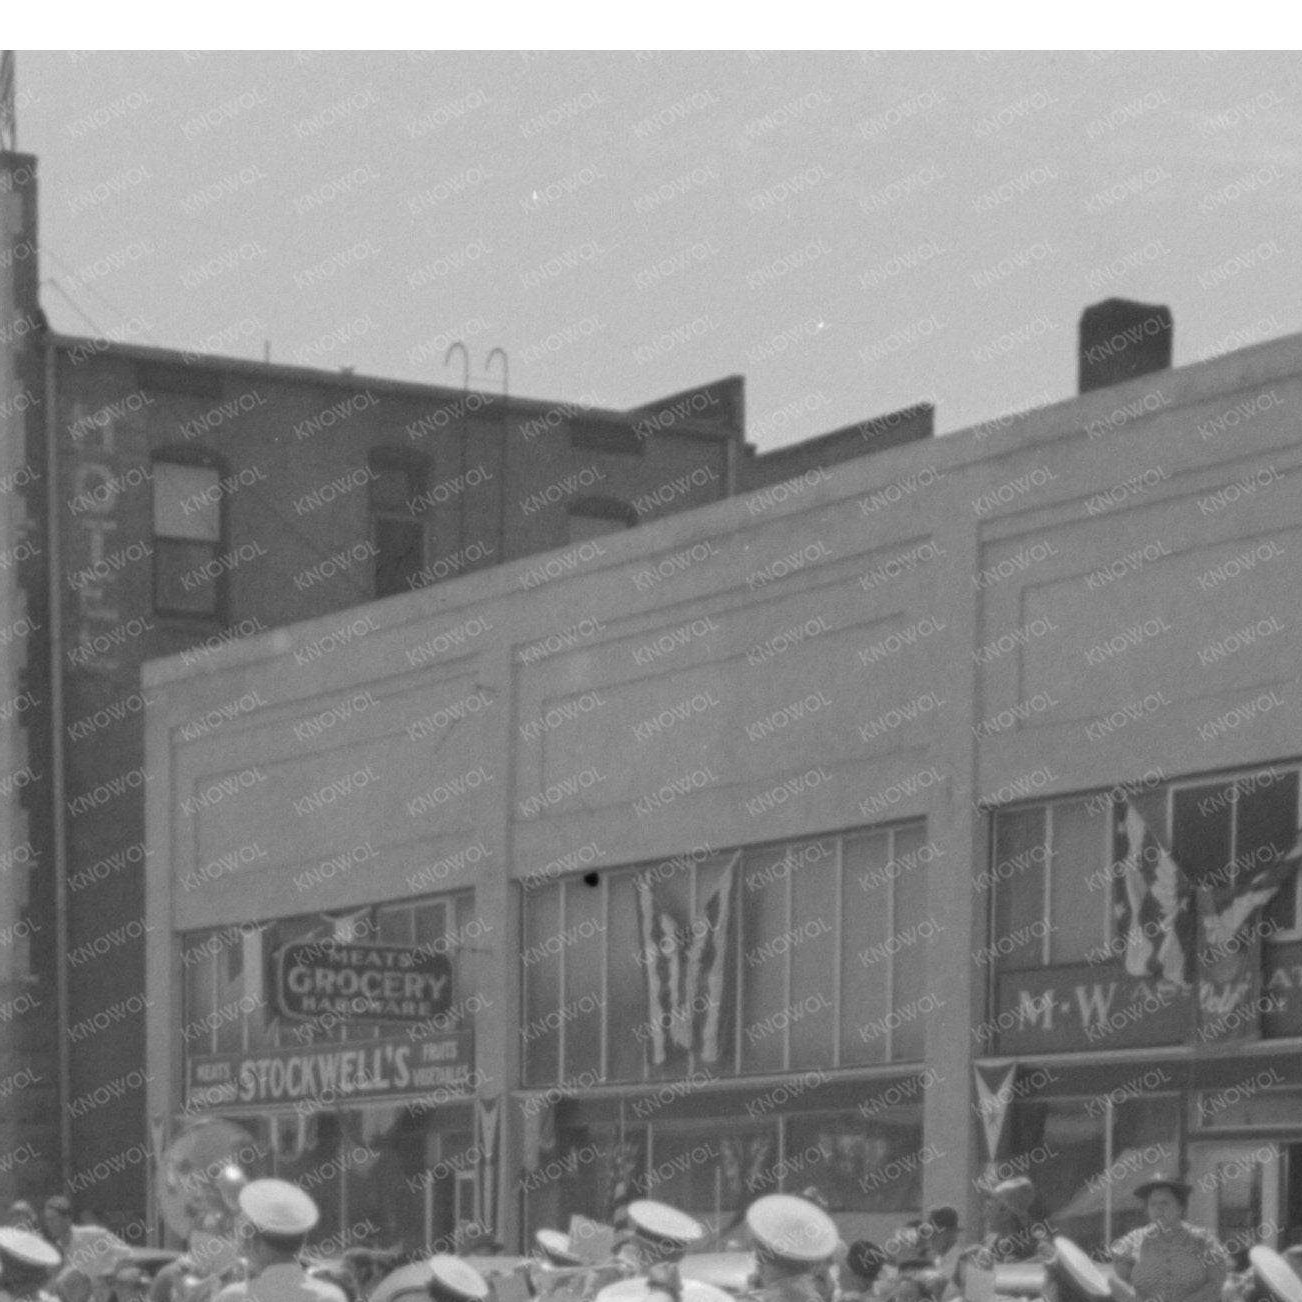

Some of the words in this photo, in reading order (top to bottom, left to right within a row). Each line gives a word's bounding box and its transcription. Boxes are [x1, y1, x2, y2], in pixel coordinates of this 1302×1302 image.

[71, 402, 121, 672] HOTEL
[327, 948, 413, 968] MEATS
[286, 965, 448, 1001] GROCERY
[301, 995, 433, 1018] HARDWARE
[239, 1043, 412, 1102] STOCKWELL'S
